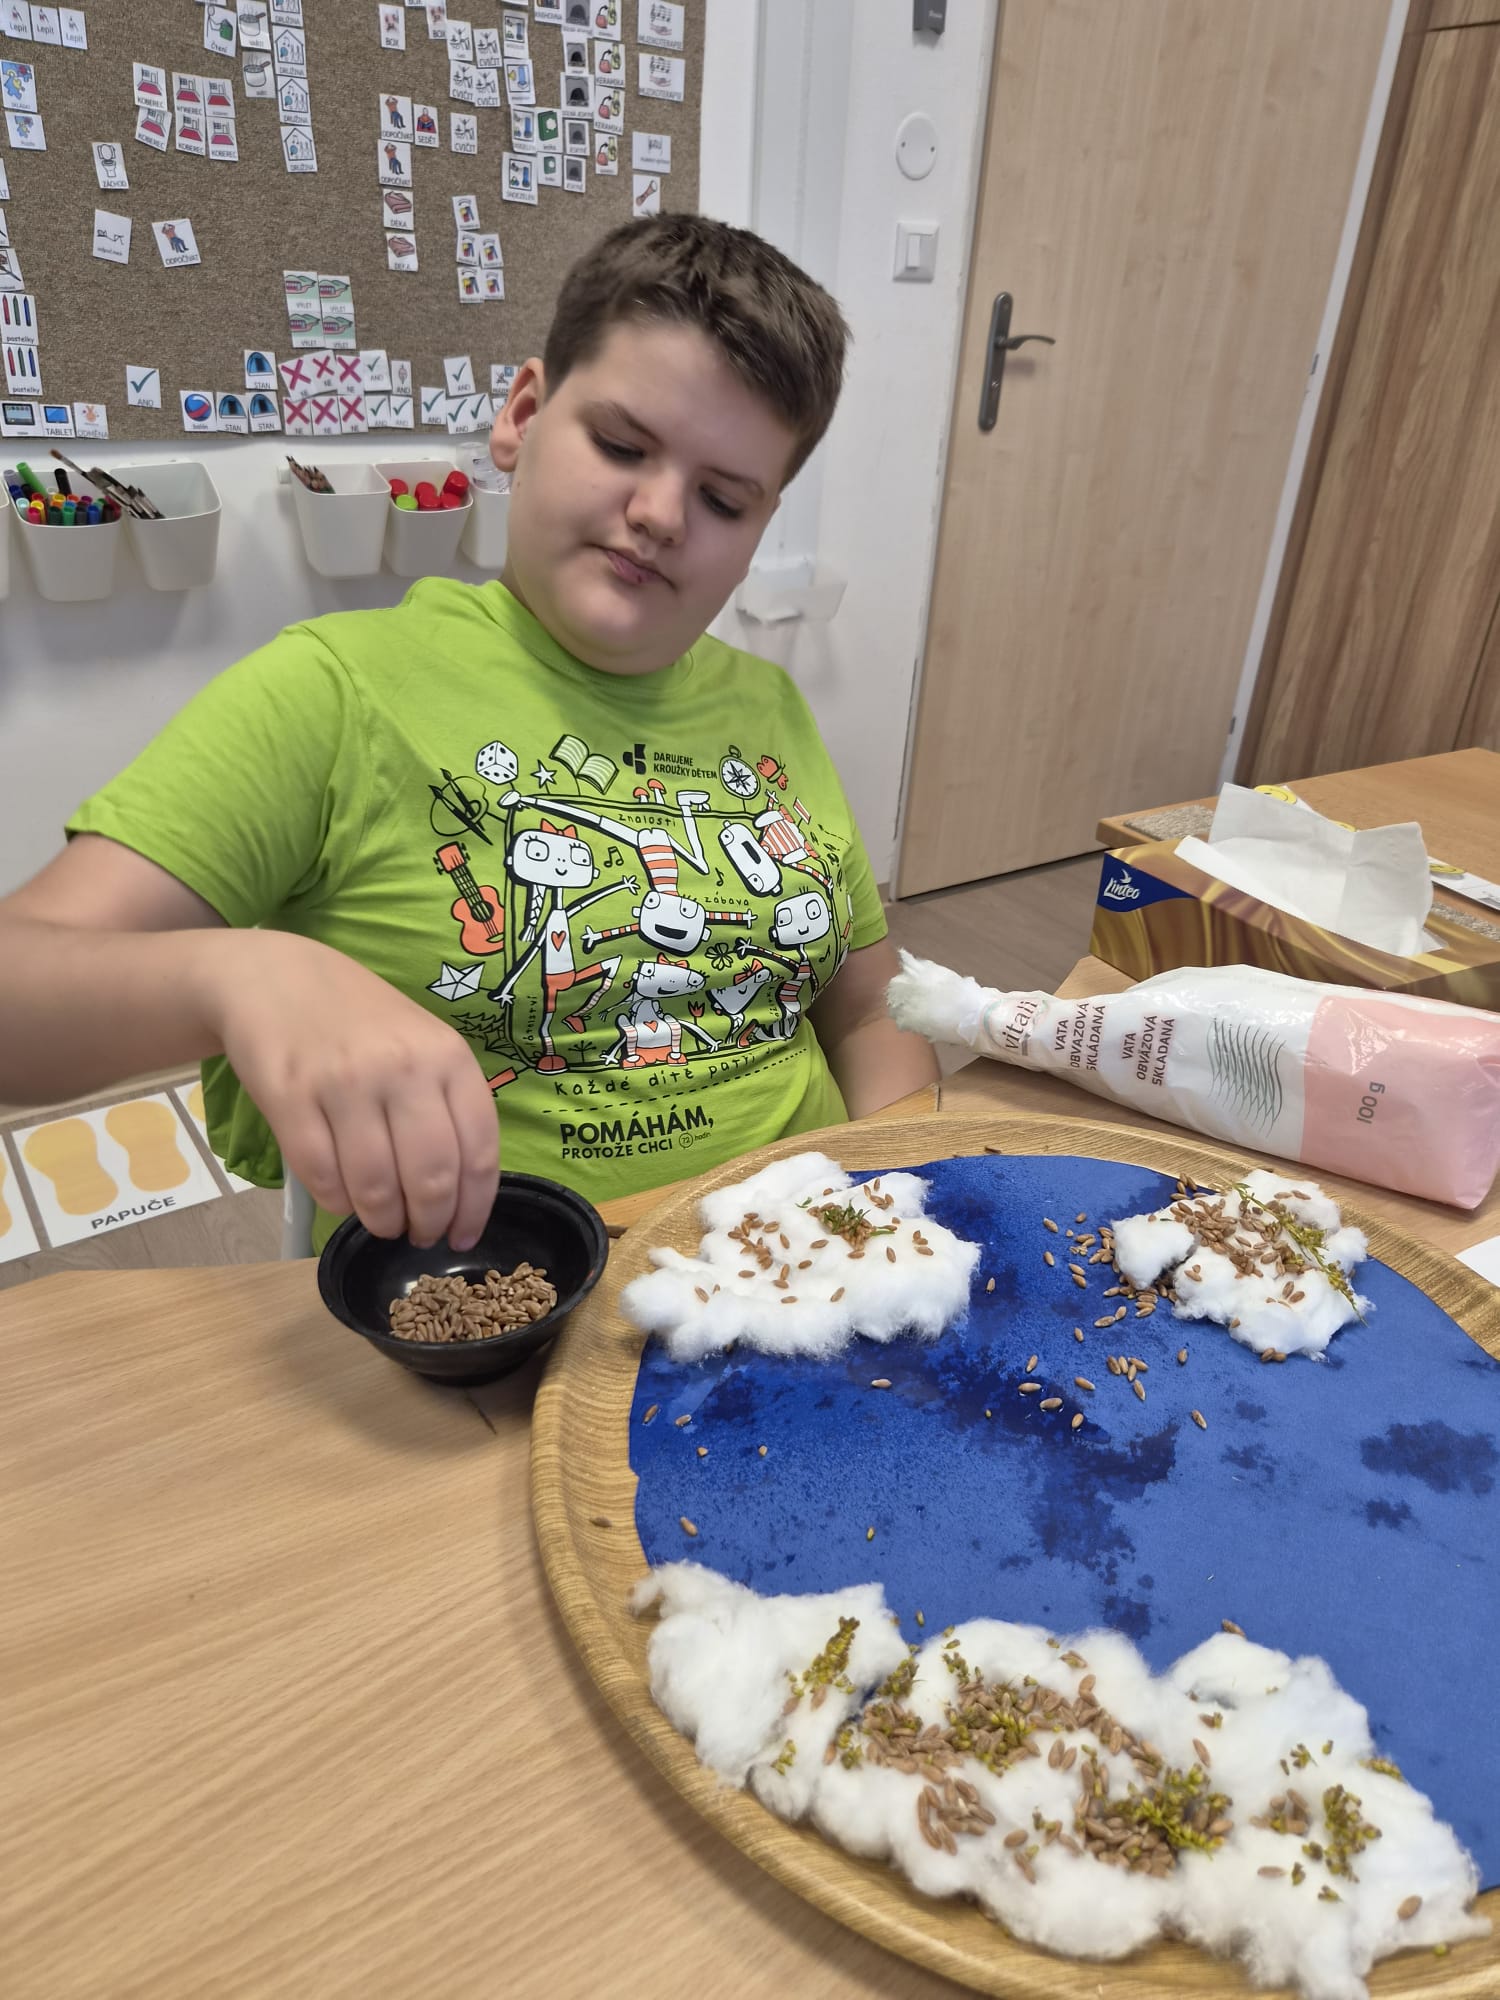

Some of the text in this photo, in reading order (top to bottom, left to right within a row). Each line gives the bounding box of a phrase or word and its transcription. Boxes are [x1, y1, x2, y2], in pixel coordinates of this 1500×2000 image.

[138, 96, 163, 109] KOBEREC
[138, 134, 165, 149] KOBEREC
[454, 142, 475, 152] CVIČIT
[7, 335, 35, 344] pastelky
[12, 386, 40, 394] pastelky
[254, 382, 271, 390] STAN
[137, 399, 154, 407] ANO
[46, 428, 73, 436] TABLET
[225, 424, 242, 433] STAN
[258, 422, 275, 430] STAN
[654, 752, 693, 766] DARUJEME
[654, 764, 718, 779] KROUŽKY DĚTEM
[1103, 877, 1141, 901] Linteo
[1002, 1000, 1038, 1050] vitali
[1054, 1019, 1069, 1051] VATA
[1070, 1002, 1090, 1068] OBVAZOVÁ
[1086, 1005, 1106, 1071] SKLÁDANÁ
[1122, 1032, 1137, 1059] VATA
[1355, 1080, 1386, 1125] 100 g
[560, 1104, 714, 1144] POMÁHÁM,
[562, 1138, 673, 1159] PROTOŽE CHCI
[91, 1196, 177, 1230] PAPUČE
